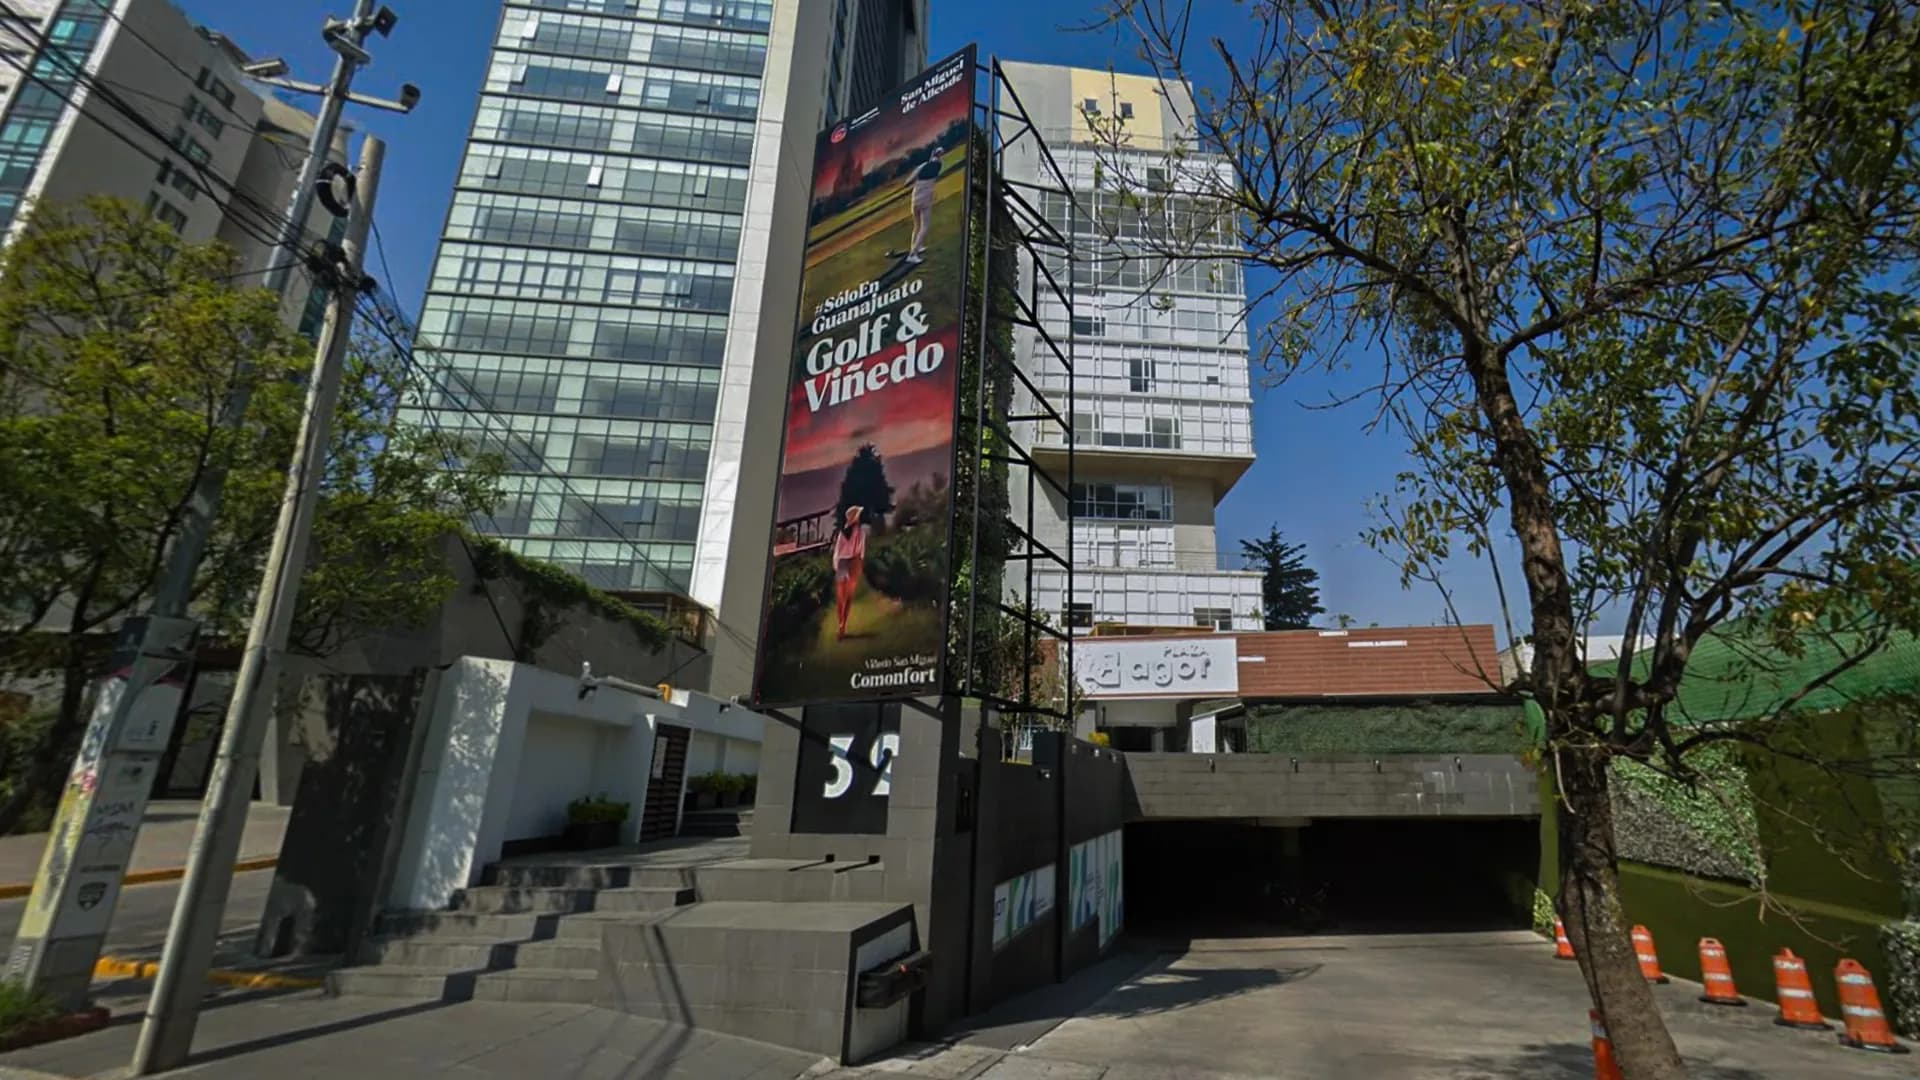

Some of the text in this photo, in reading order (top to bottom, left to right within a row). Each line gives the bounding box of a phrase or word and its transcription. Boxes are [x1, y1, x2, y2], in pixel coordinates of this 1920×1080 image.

[901, 86, 922, 105] San
[924, 59, 965, 90] Miguel
[902, 72, 963, 114] de Allende
[811, 279, 923, 335] Guanajuato
[806, 302, 930, 376] Golf &
[804, 338, 945, 413] Viñedo
[850, 667, 936, 689] Comonfort
